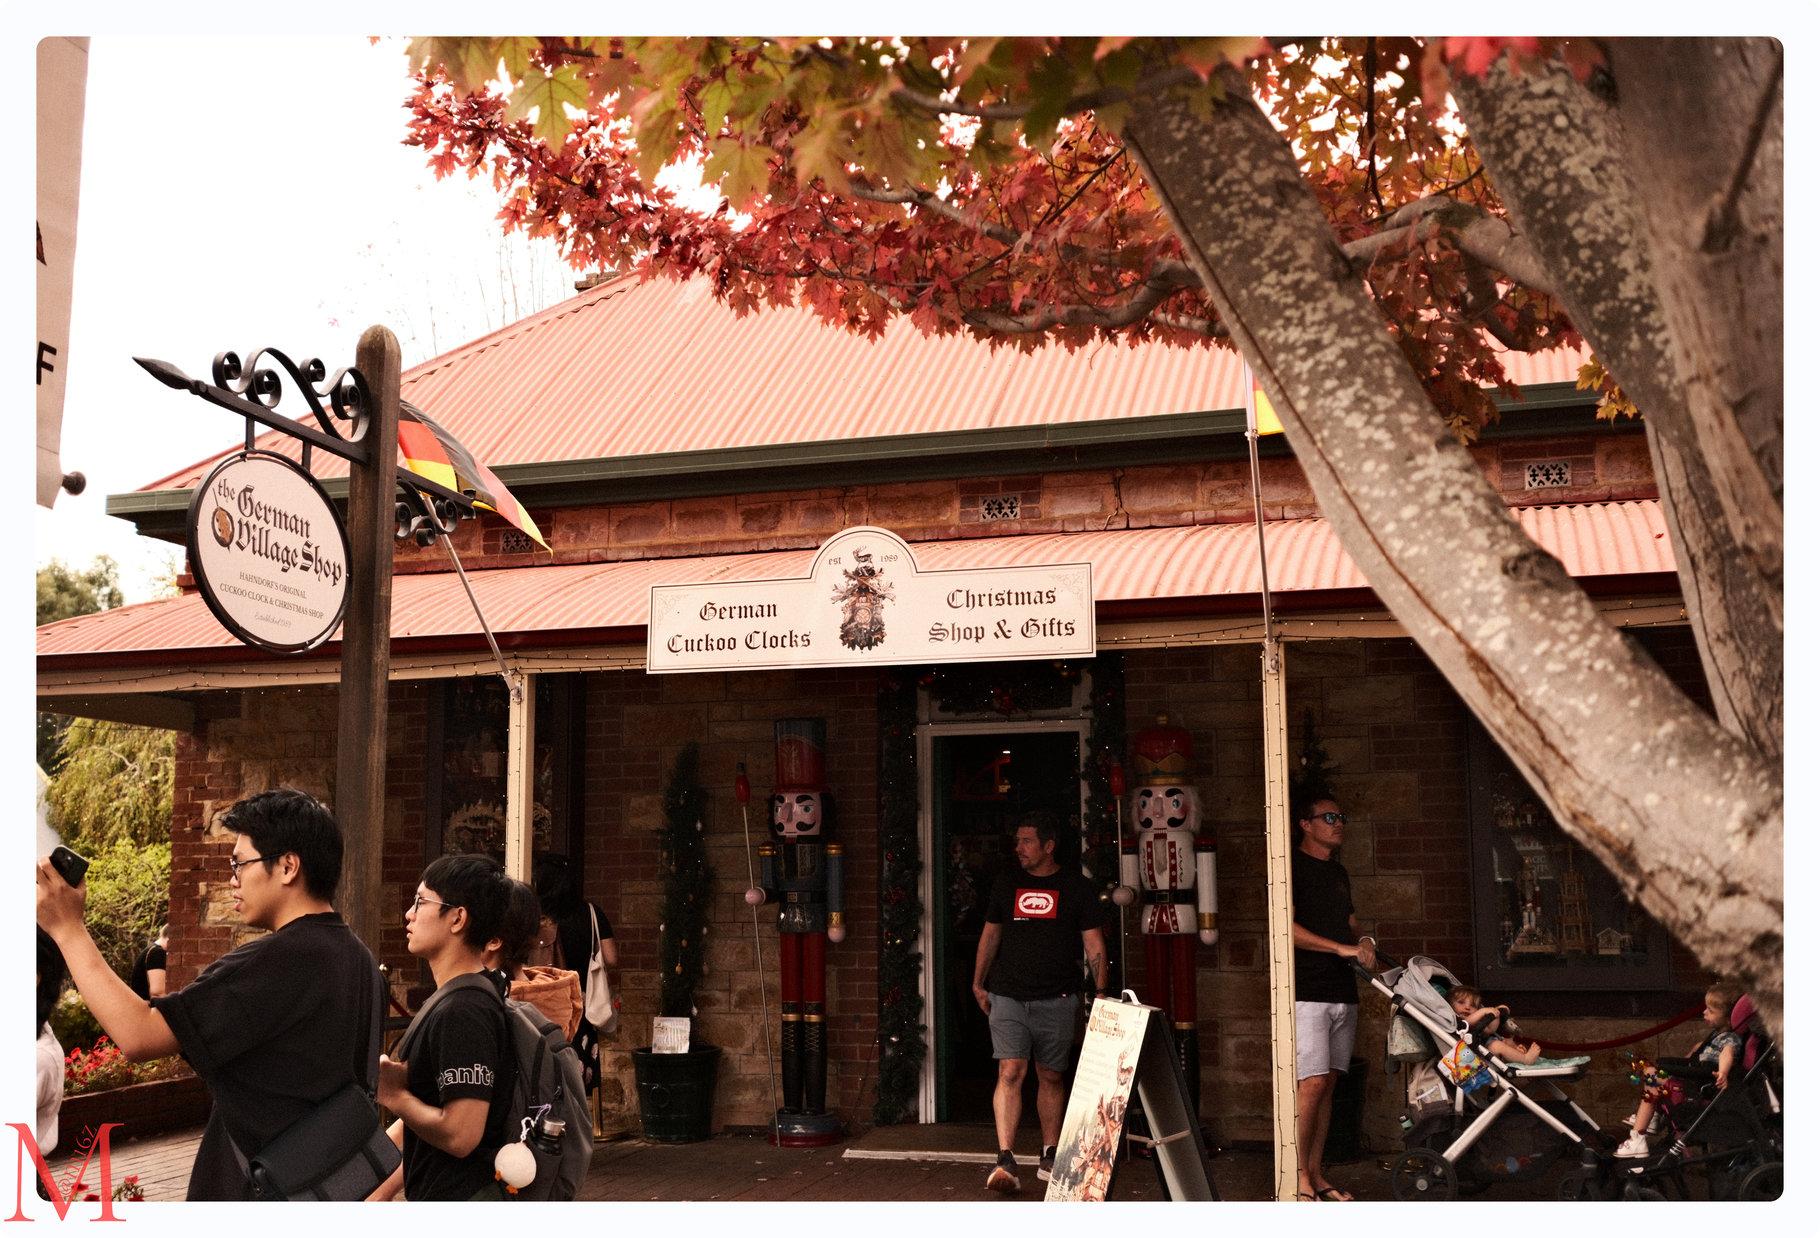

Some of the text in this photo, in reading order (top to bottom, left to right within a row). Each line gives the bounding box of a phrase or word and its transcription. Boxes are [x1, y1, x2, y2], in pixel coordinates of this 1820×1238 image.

[218, 478, 311, 539] the German
[235, 517, 342, 587] Village Shop
[828, 553, 898, 566] est 1989
[219, 583, 325, 620] CUCKOO CLOCK & CHRISTMAS SHOP
[279, 583, 308, 599] ORIGINAL
[946, 587, 1057, 612] Christmas
[699, 601, 778, 621] German
[667, 629, 812, 653] Cuckoo Clocks
[928, 617, 1076, 644] Shop & Gifts
